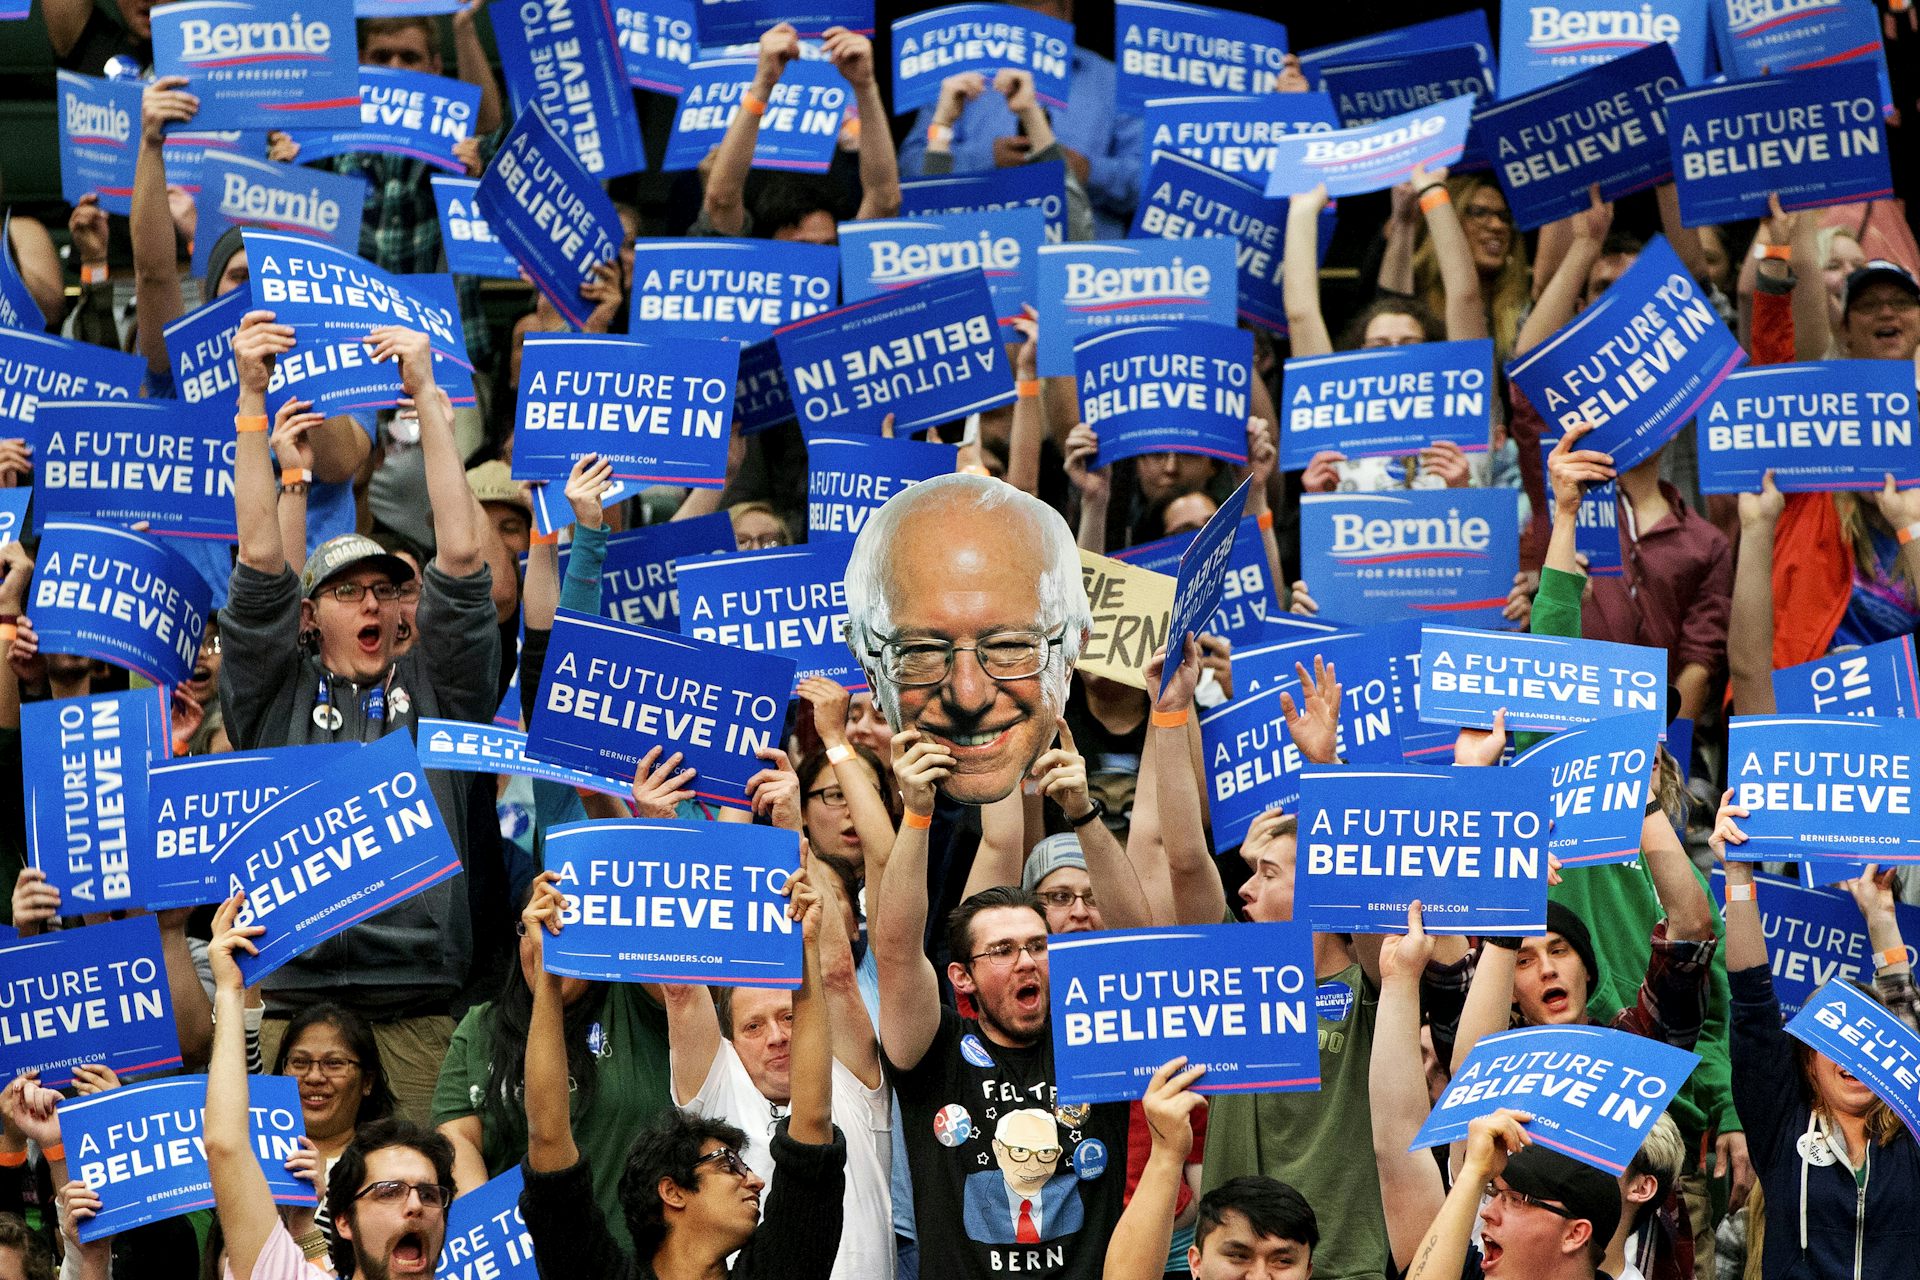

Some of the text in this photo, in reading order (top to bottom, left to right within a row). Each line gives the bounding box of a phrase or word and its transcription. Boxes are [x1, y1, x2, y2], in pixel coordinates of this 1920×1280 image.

[180, 12, 331, 57] Bernie
[654, 15, 693, 40] TO
[921, 23, 1068, 58] FUTURE TO
[1147, 27, 1245, 62] FUTURE
[1529, 6, 1680, 46] Bernie
[656, 36, 692, 64] IN
[900, 40, 1066, 80] BELIEVE IN
[1123, 48, 1245, 91] BELIEVE
[1551, 55, 1577, 65] FOR
[208, 69, 308, 80] FOR PRESIDENT
[432, 97, 470, 120] TO
[555, 37, 605, 174] BELIEVE
[809, 87, 845, 109] TO
[1356, 80, 1446, 113] FUTURE
[66, 93, 130, 141] Bernie
[429, 114, 467, 141] IN
[801, 110, 838, 136] IN
[1177, 122, 1286, 144] FUTURE
[1519, 92, 1634, 149] FUTURE
[1707, 98, 1876, 143] FUTURE TO
[1304, 115, 1446, 162] Bernie
[1504, 116, 1648, 188] BELIEVE
[1683, 134, 1830, 181] BELIEVE
[1841, 126, 1879, 158] IN
[222, 173, 340, 231] Bernie
[496, 150, 585, 261] BELIEVE
[522, 146, 596, 236] FUTURE
[1177, 189, 1280, 250] FUTURE
[869, 230, 1020, 281] Bernie
[261, 255, 401, 303] A FUTURE
[670, 270, 830, 300] FUTURE TO
[1065, 256, 1210, 304] Bernie
[262, 278, 455, 344] BELIEVE IN
[640, 295, 782, 325] BELIEVE
[1086, 316, 1113, 326] FOR
[842, 315, 992, 381] BELIEVE
[1544, 274, 1693, 412] A FUTURE TO
[794, 358, 837, 394] IN
[1100, 355, 1247, 387] FUTURE TO
[1319, 368, 1484, 402] FUTURE TO
[1559, 297, 1715, 436] BELIEVE IN
[529, 371, 547, 395] A
[555, 372, 674, 399] FUTURE
[683, 377, 726, 403] TO
[804, 355, 971, 422] FUTURE TO
[1083, 382, 1245, 425] BELIEVE IN
[1635, 375, 1701, 437] BERNIESANDERS.COM
[525, 402, 723, 439] BELIEVE IN
[1290, 393, 1483, 432] BELIEVE IN
[1708, 392, 1910, 422] A FUTURE TO
[47, 431, 192, 460] A FUTURE
[1709, 419, 1912, 451] BELIEVE IN
[45, 462, 192, 493] BELIEVE
[817, 472, 891, 500] FUTURE
[96, 509, 183, 522] BERNIESANDERS.COM
[1332, 508, 1490, 555] Bernie
[43, 552, 180, 609] A FUTURE
[1184, 527, 1237, 609] BELIEVE
[1357, 567, 1463, 579] FOR PRESIDENT
[692, 581, 846, 621] A FUTURE
[1178, 572, 1218, 638] FUTURE
[36, 580, 197, 670] BELIEVE IN
[1079, 613, 1169, 670] ERN
[76, 630, 158, 666] BERNIESANDERS.COM
[555, 652, 777, 722] A FUTURE TO
[1434, 652, 1657, 688] A FUTURE TO
[1811, 667, 1838, 712] TO
[1840, 657, 1872, 699] IN
[1432, 672, 1657, 710] BELIEVE IN
[547, 682, 771, 756] BELIEVE IN
[1214, 679, 1385, 767] A TO
[1354, 707, 1391, 745] IN
[1608, 749, 1645, 776] TO
[1741, 752, 1911, 779] A FUTURE
[60, 705, 94, 873] FUTURE TO
[91, 699, 131, 900] BELIEVE IN
[1602, 780, 1641, 811] IN
[1740, 783, 1911, 814] BELIEVE
[158, 798, 176, 823] A
[246, 772, 417, 881] FUTURE TO
[1310, 809, 1540, 839] A FUTURE TO
[1800, 834, 1900, 845] BERNIESANDERS.COM
[233, 800, 433, 930] BELIEVE IN
[557, 861, 791, 895] A FUTURE TO
[1308, 844, 1538, 879] BELIEVE IN
[295, 879, 385, 932] BERNIESANDERS.COM
[560, 894, 792, 934] BELIEVE IN
[108, 957, 156, 987] TO
[618, 952, 722, 964] BERNIESANDERS.COM
[1065, 965, 1304, 1006] A FUTURE TO
[119, 989, 163, 1023] IN
[1065, 1001, 1307, 1046] BELIEVE IN
[1826, 1001, 1847, 1018] A
[16, 1052, 106, 1076] BERNIESANDERS.COM
[1459, 1052, 1666, 1099] A FUTURE TO
[1440, 1073, 1598, 1110] BELIEVE
[1598, 1092, 1653, 1130] IN
[79, 1133, 100, 1159] A
[990, 1245, 1064, 1272] BERN
